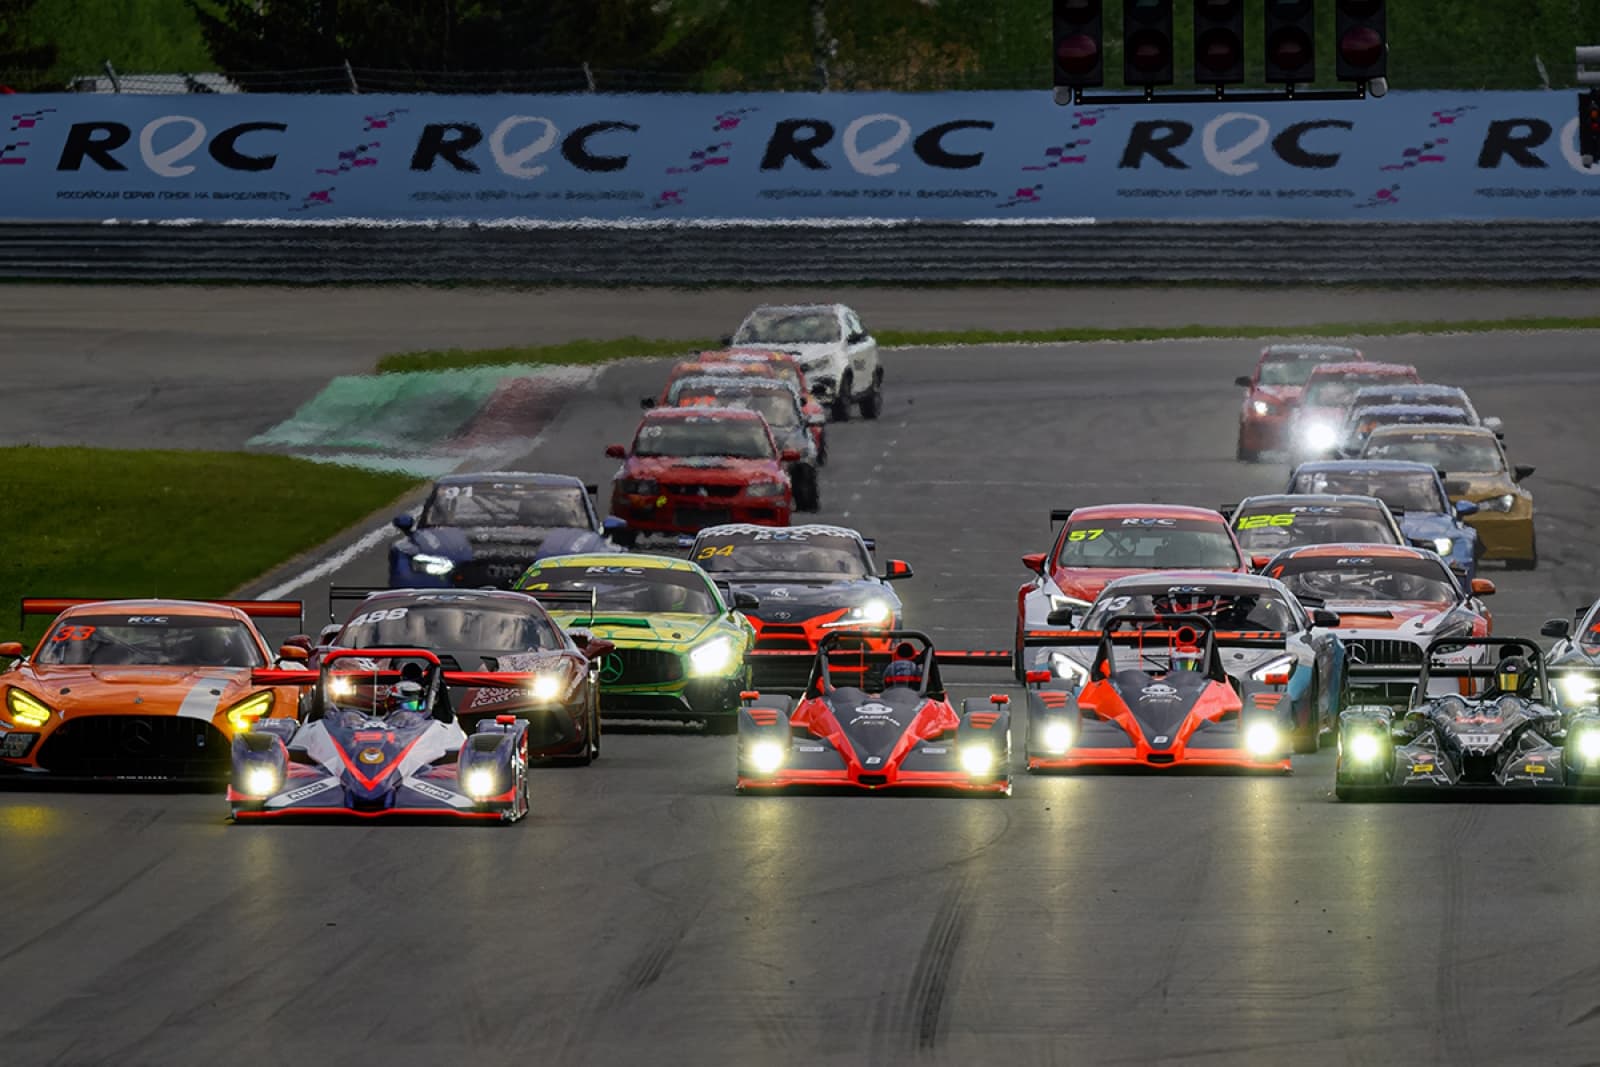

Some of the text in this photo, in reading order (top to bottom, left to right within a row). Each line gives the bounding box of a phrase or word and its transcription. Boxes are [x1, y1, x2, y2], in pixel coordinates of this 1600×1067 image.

[1237, 513, 1296, 530] 126
[1068, 529, 1104, 541] 57
[698, 545, 735, 560] 34
[1096, 595, 1132, 612] 13
[348, 608, 408, 628] 488
[52, 625, 96, 643] 33
